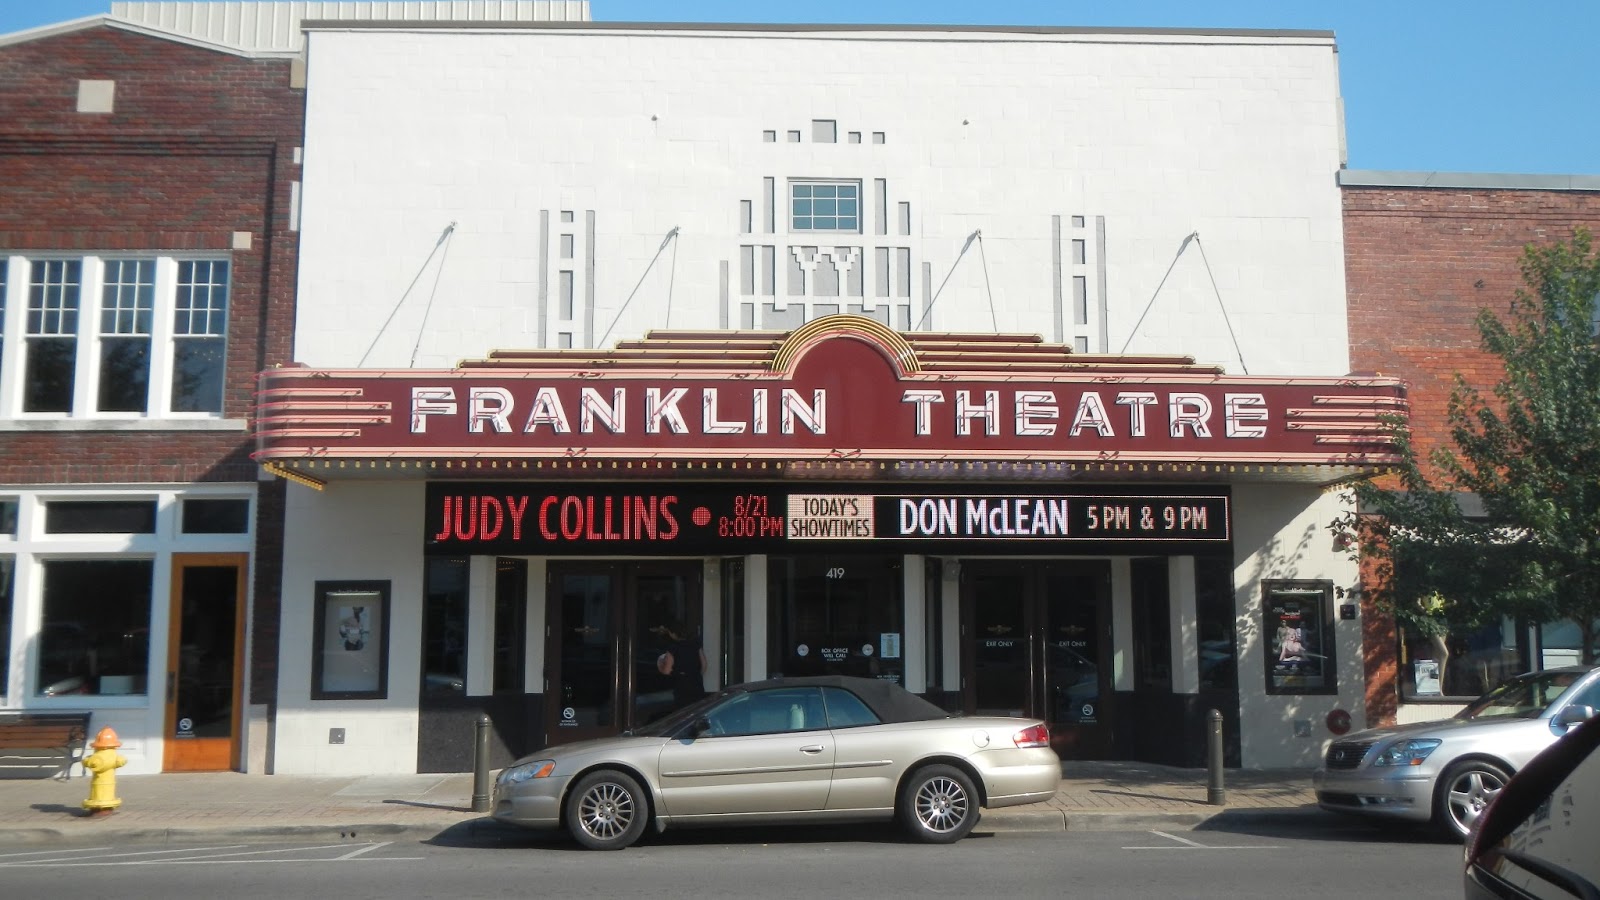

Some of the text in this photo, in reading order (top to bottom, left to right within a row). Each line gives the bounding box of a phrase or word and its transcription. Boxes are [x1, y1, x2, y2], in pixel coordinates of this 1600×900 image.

[411, 387, 1270, 438] FRANKLIN THEATRE
[436, 495, 679, 540] JUDY COLLINS
[734, 494, 768, 518] 8/21
[803, 498, 859, 516] TODAY'S
[900, 498, 1069, 535] DON McLEAN
[1087, 506, 1207, 530] 5 PM & 9 PM
[719, 516, 784, 537] 8:00 PM
[791, 519, 870, 537] SHOWTIMES
[826, 567, 845, 579] 419
